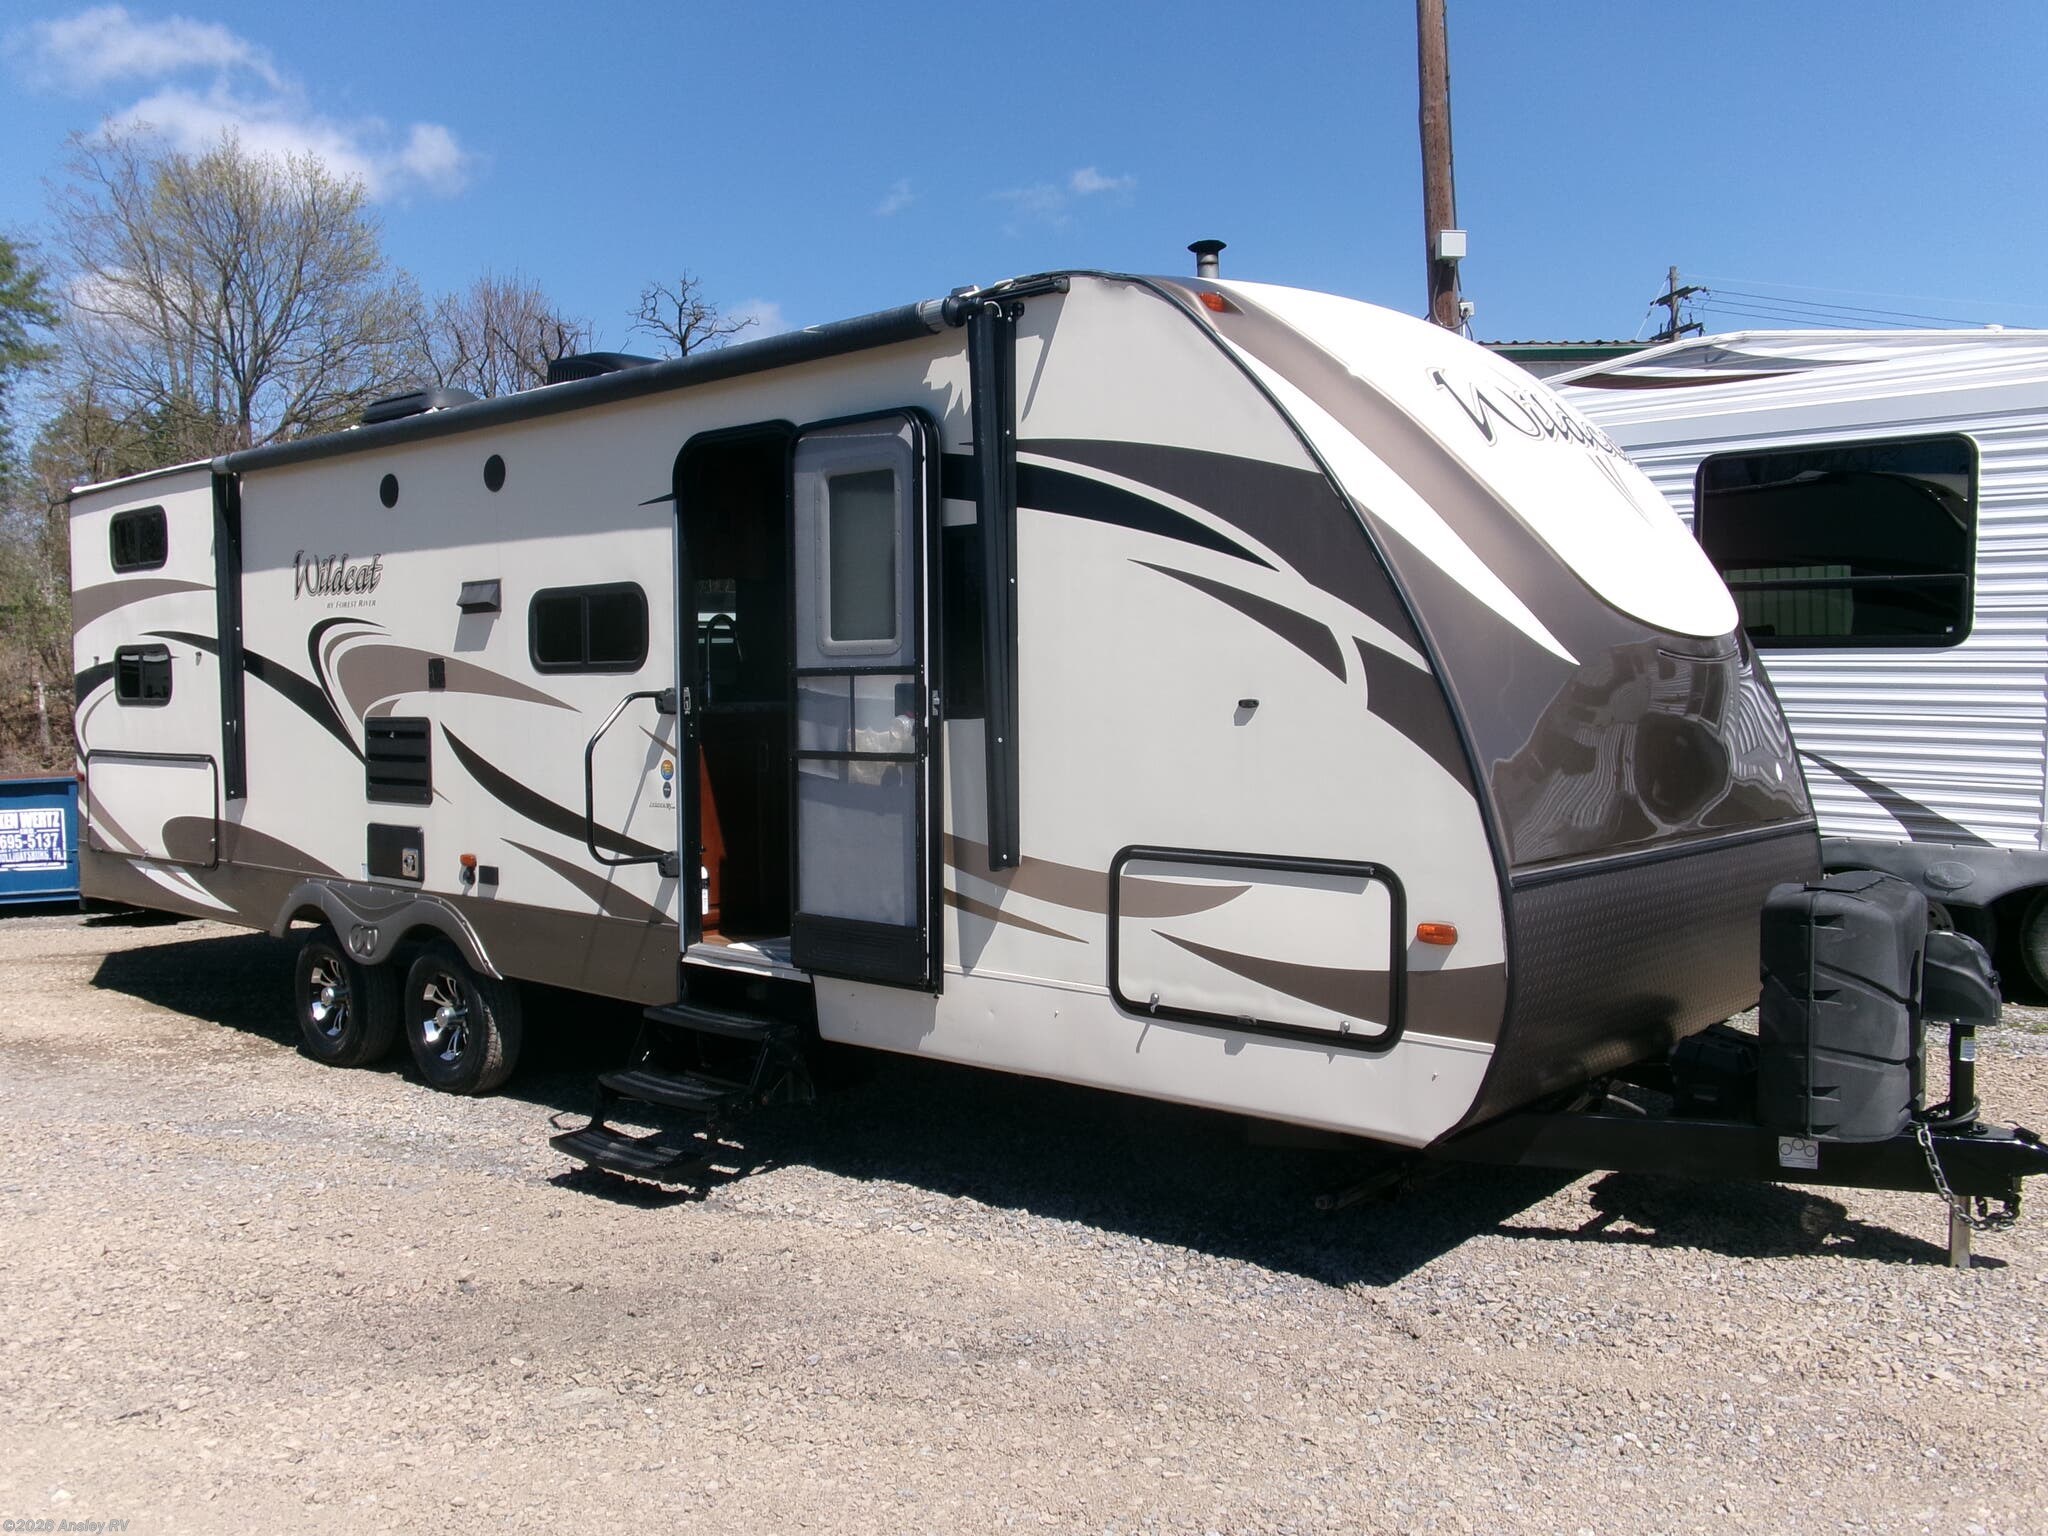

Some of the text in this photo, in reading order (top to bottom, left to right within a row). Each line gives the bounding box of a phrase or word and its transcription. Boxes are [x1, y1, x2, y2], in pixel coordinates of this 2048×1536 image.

[1426, 366, 1634, 467] Wildca
[293, 549, 383, 601] Wildcat
[335, 600, 357, 608] FOREST
[358, 599, 377, 607] RIVER
[19, 811, 60, 828] WERTZ
[0, 833, 59, 849] 695-5137
